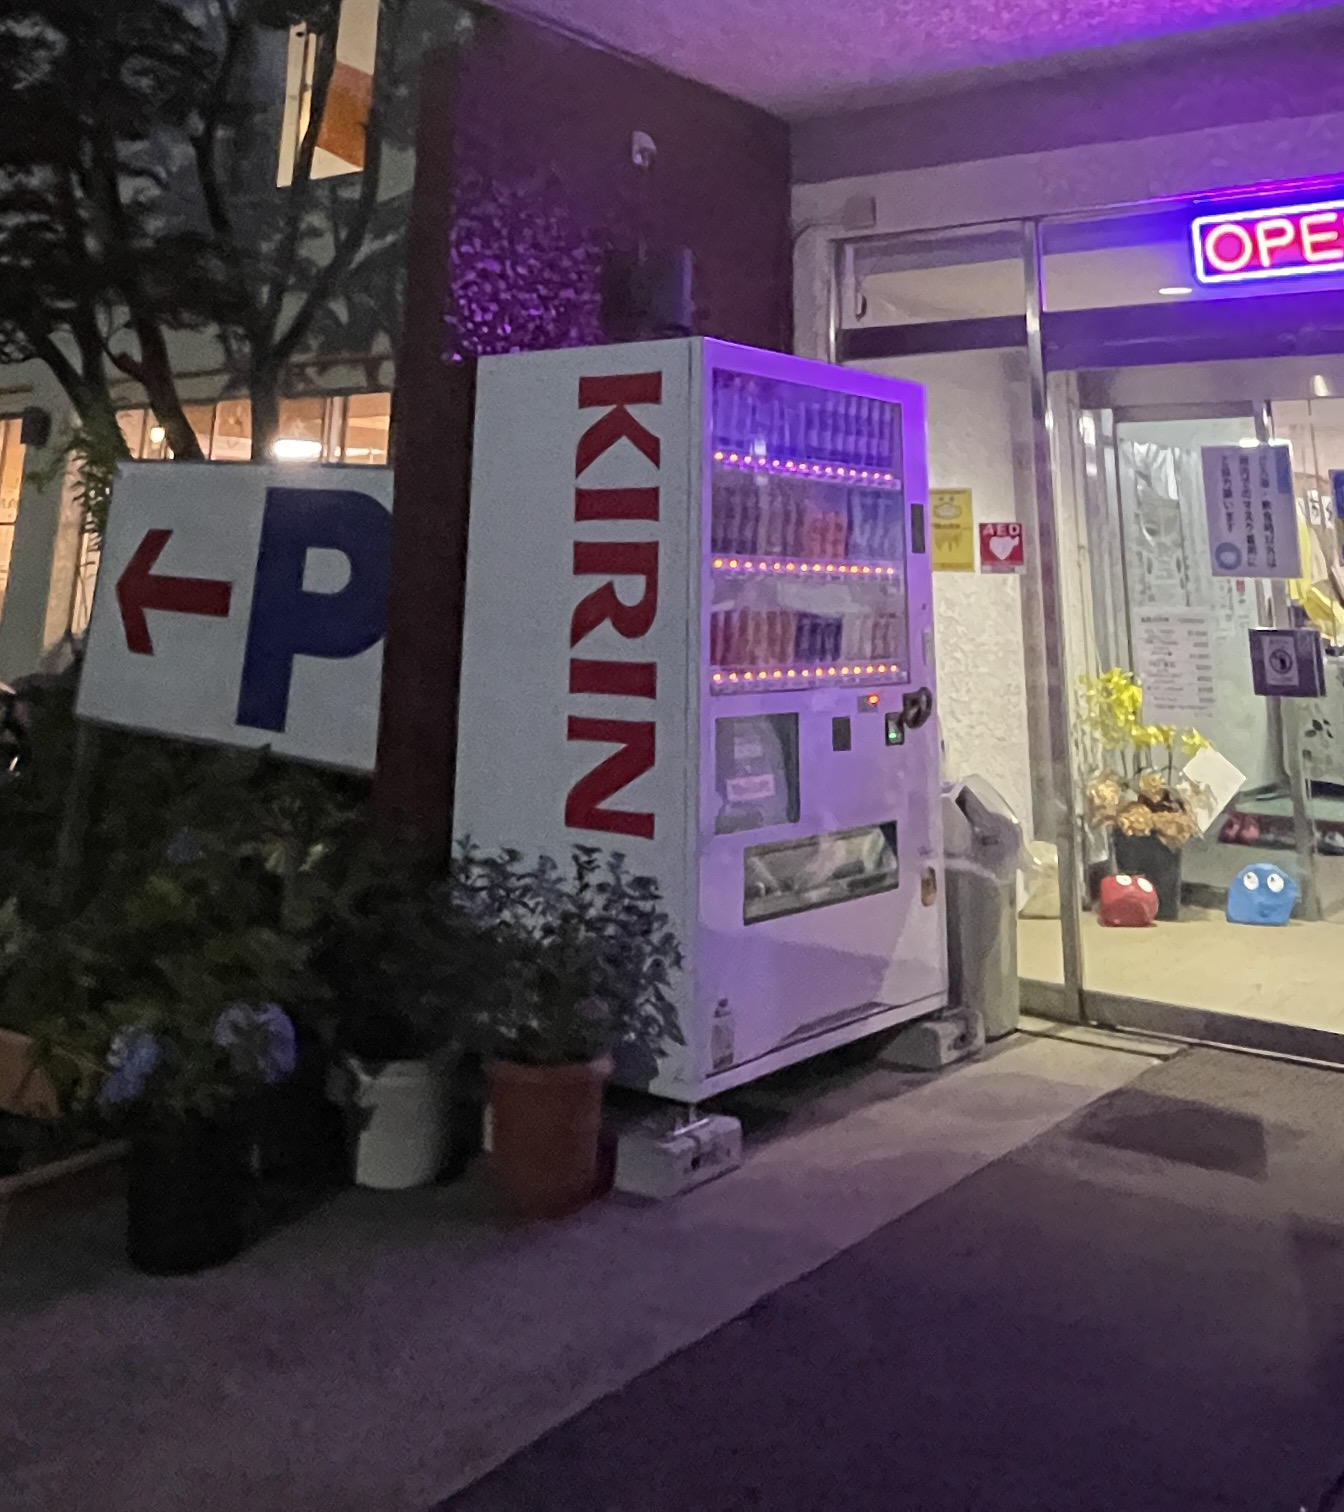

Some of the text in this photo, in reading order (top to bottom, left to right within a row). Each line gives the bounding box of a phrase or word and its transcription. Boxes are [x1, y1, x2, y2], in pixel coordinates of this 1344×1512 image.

[235, 486, 394, 734] P
[563, 370, 663, 840] KIRIN
[982, 523, 1021, 536] AED
